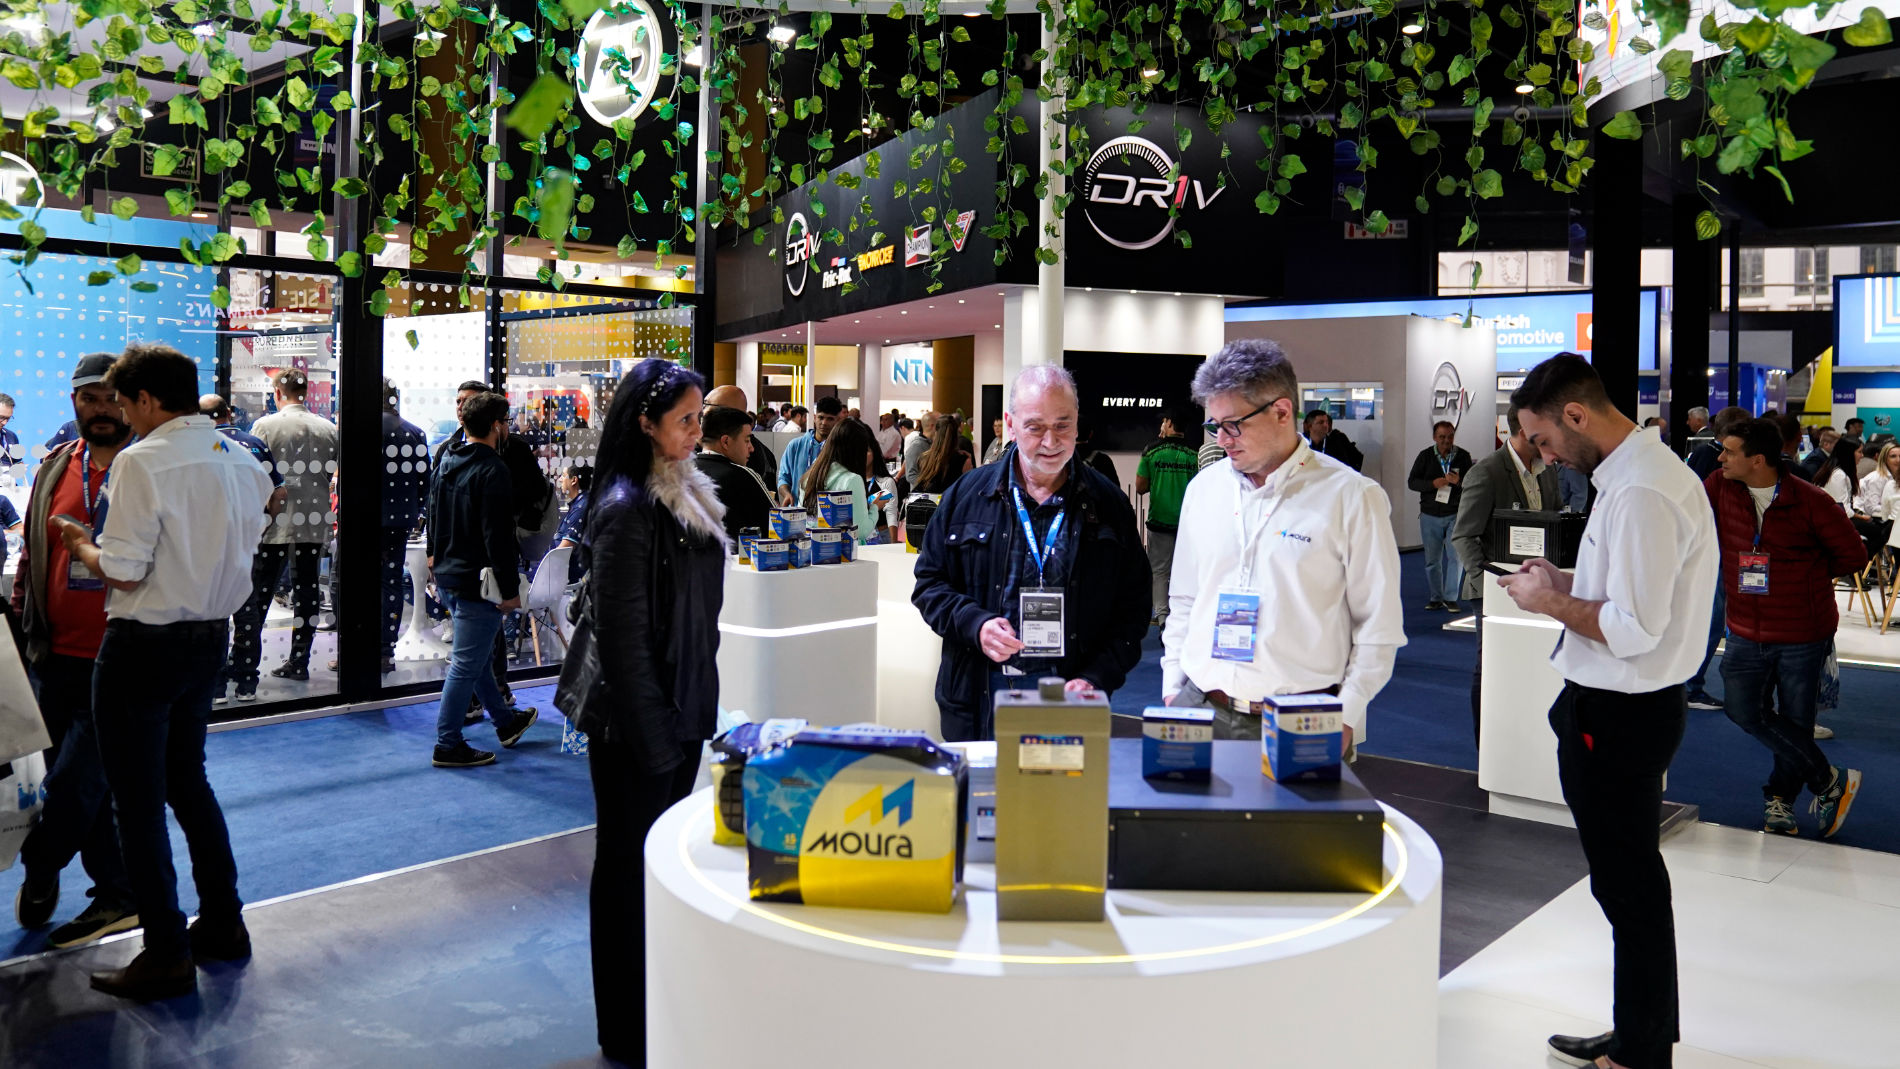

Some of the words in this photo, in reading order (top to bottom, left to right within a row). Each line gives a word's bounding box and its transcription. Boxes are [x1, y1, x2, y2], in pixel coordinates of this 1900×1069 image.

[907, 238, 930, 254] CHAMPION
[859, 245, 895, 271] MONROE
[1102, 397, 1136, 407] EVERY
[1138, 398, 1163, 407] RIDE
